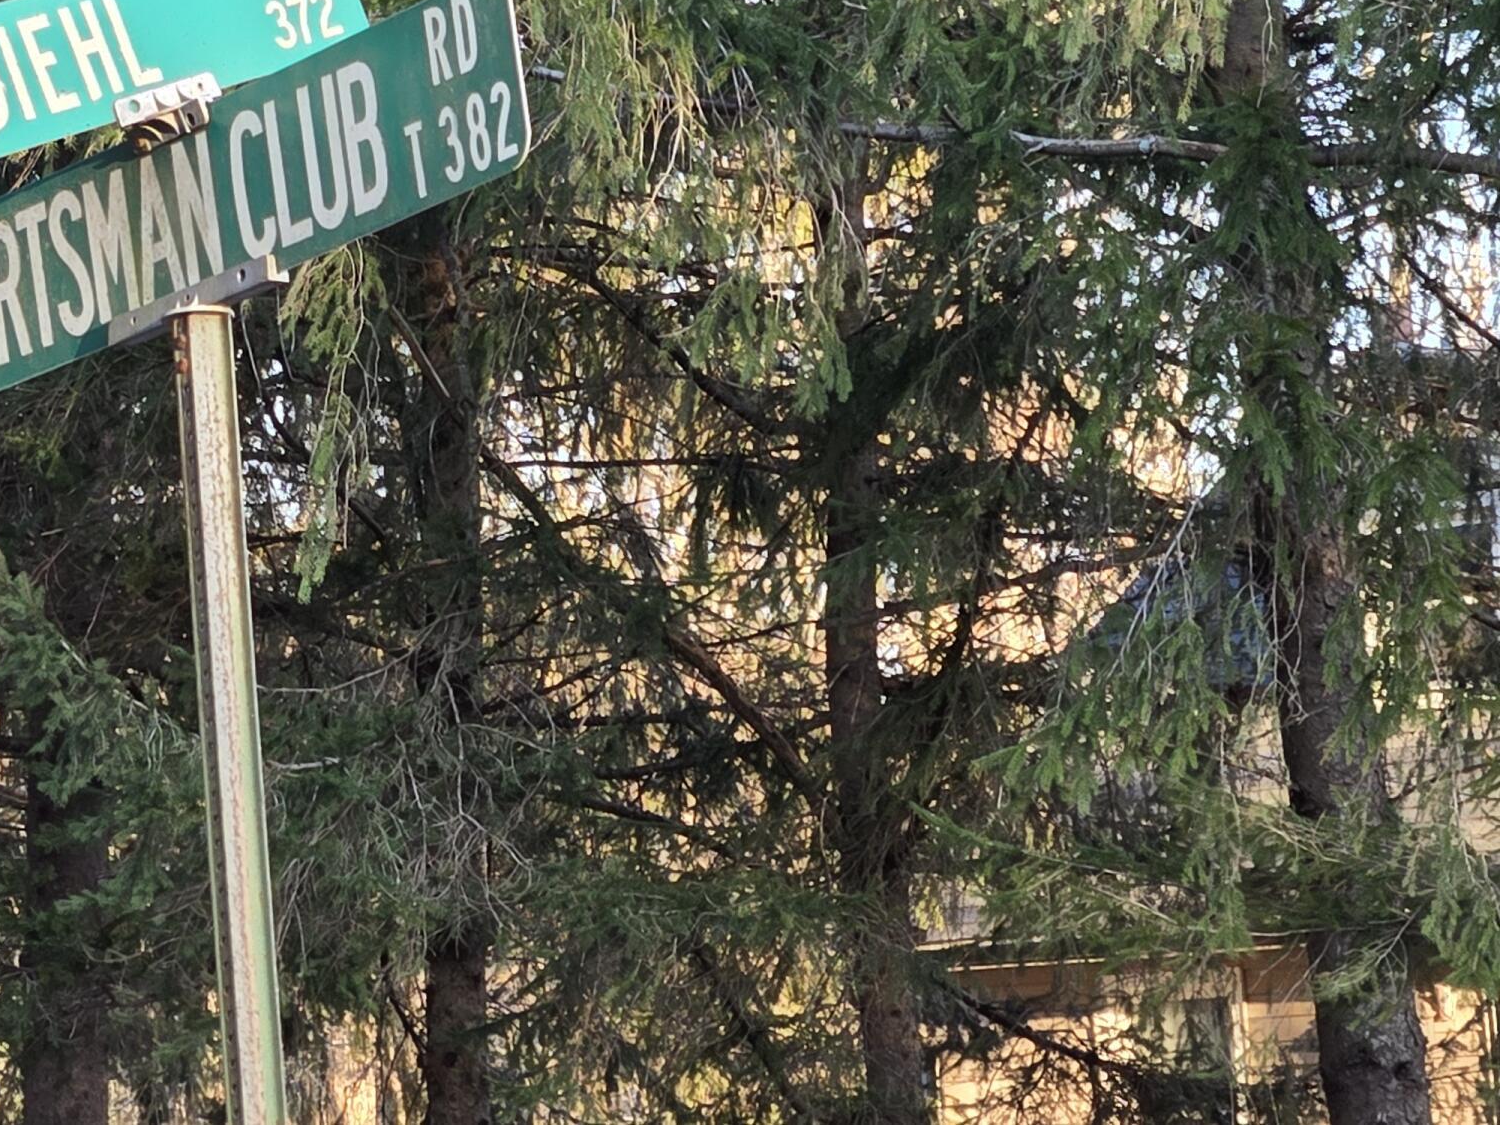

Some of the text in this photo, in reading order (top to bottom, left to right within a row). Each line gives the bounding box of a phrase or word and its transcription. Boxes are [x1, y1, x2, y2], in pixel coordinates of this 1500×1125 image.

[230, 60, 388, 259] CLUB
[404, 81, 519, 198] T 382
